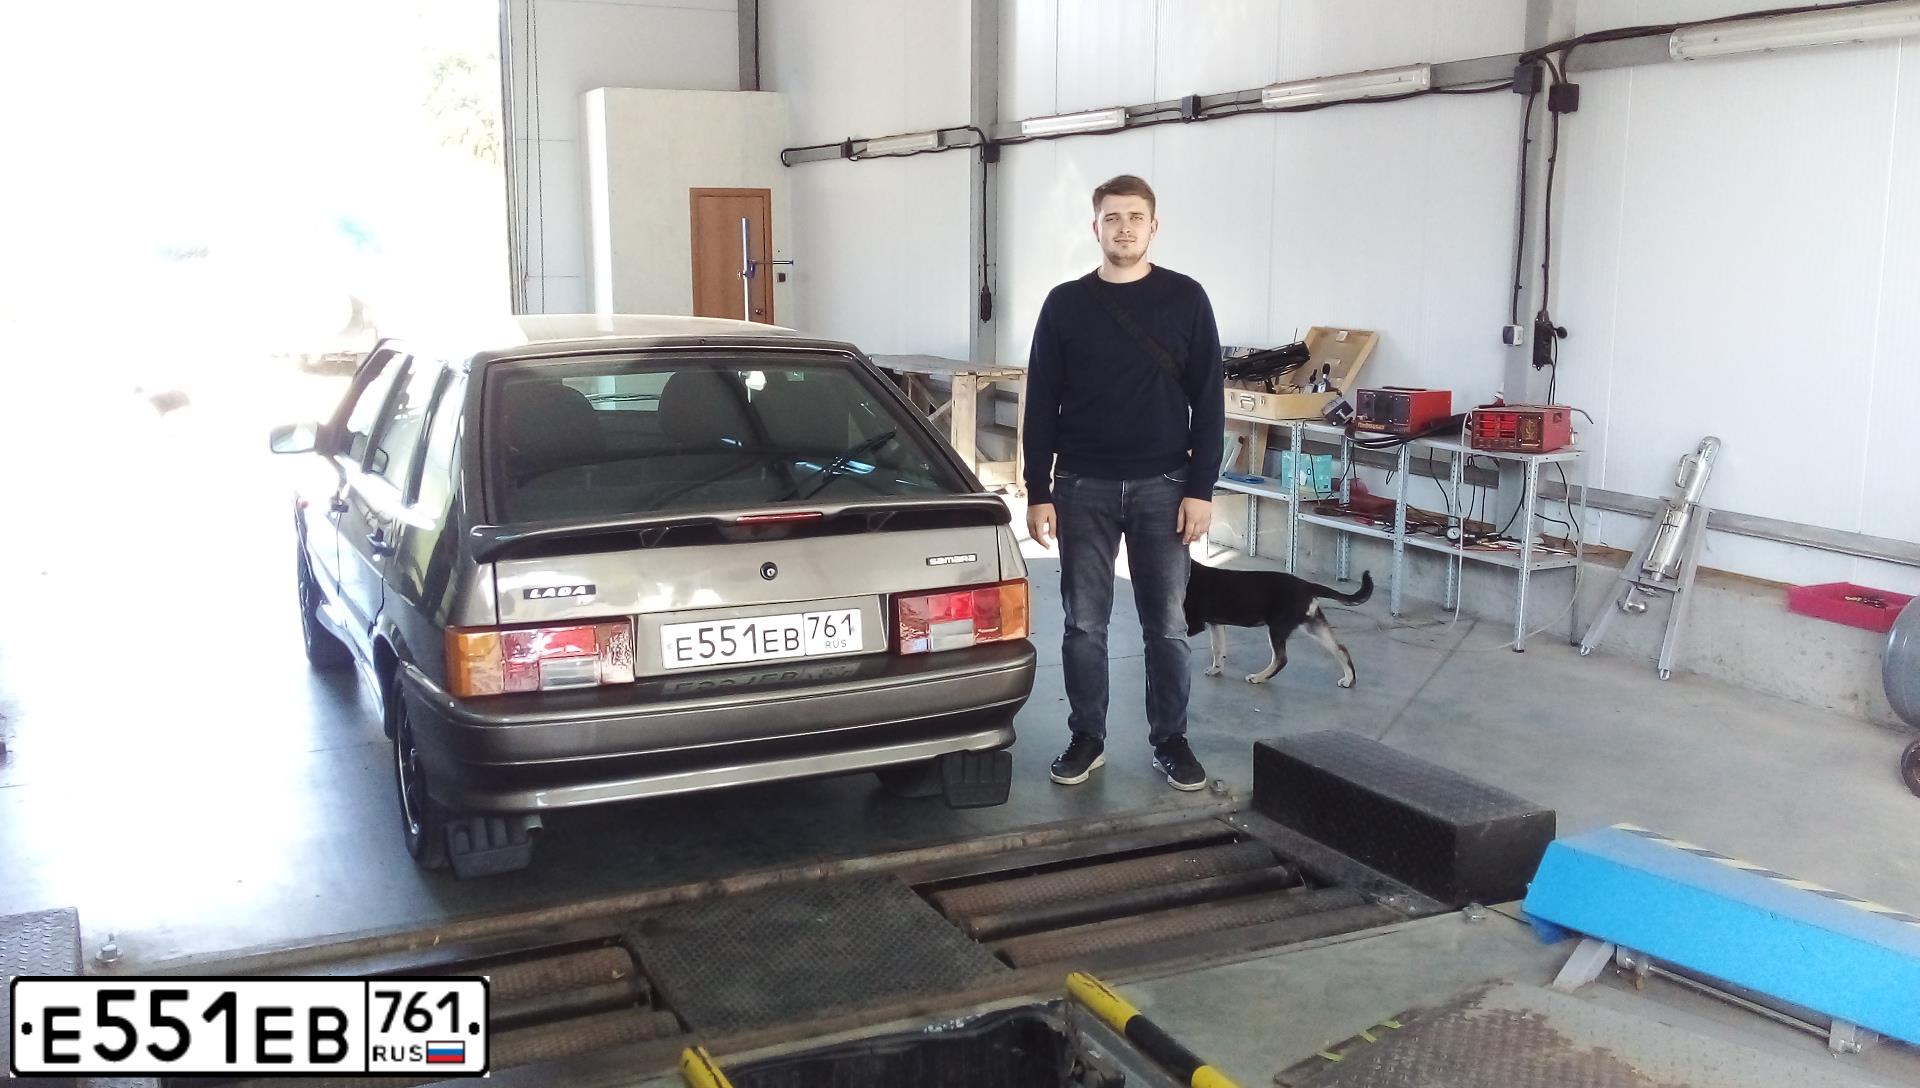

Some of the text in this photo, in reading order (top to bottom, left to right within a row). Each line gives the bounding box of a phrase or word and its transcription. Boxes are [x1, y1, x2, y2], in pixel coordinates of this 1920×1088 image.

[529, 585, 587, 599] LADA
[807, 613, 852, 640] 761
[825, 639, 847, 649] RUS
